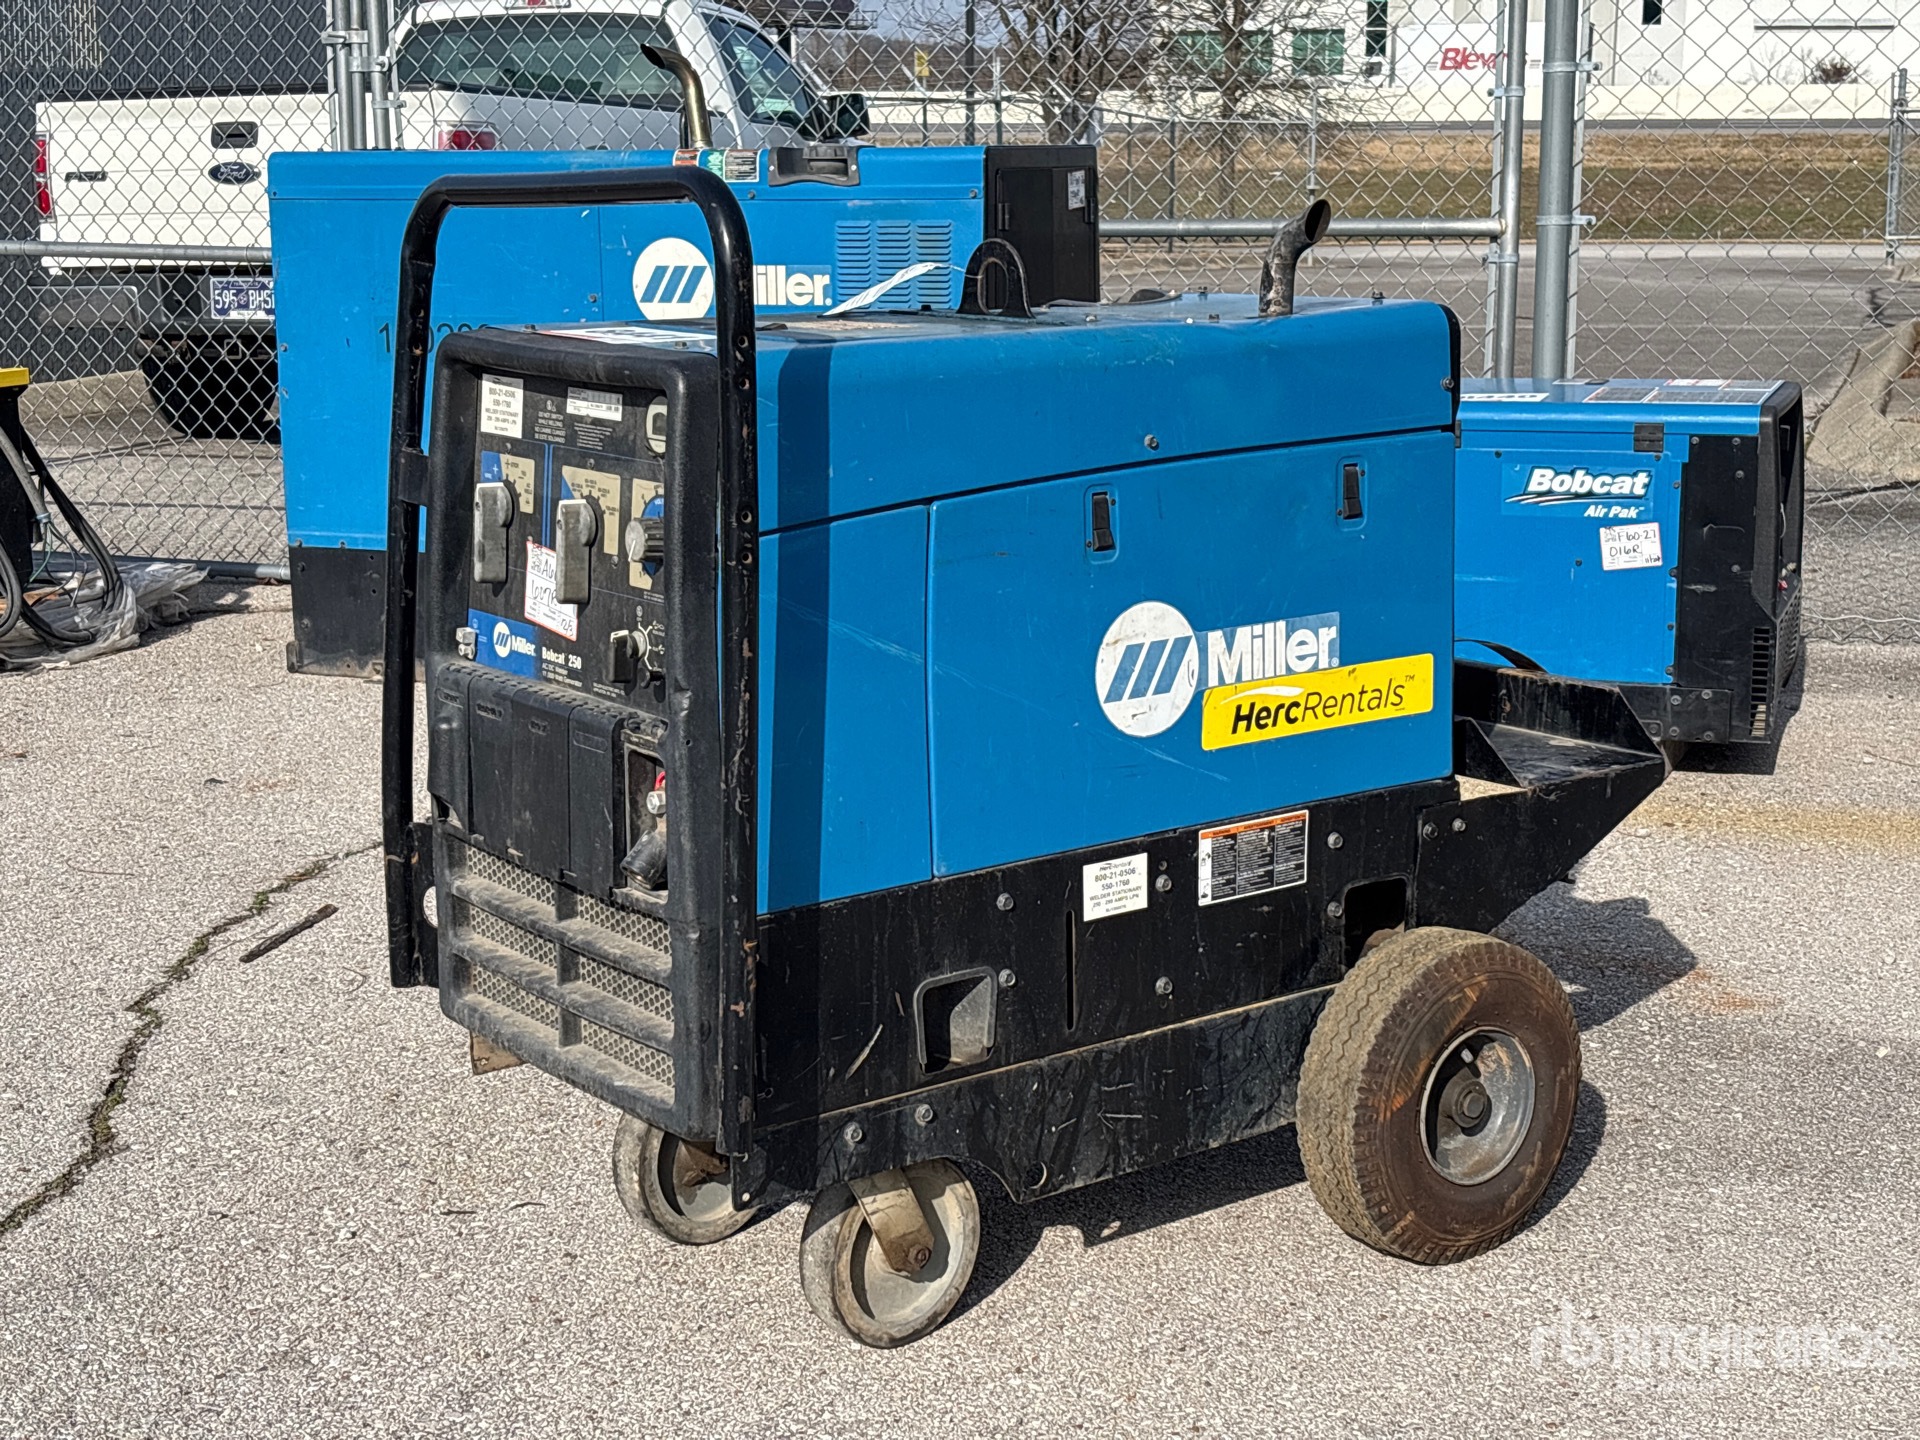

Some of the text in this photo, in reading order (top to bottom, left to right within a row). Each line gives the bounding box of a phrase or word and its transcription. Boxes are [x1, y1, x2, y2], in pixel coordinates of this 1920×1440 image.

[753, 265, 830, 306] iller
[214, 289, 275, 309] 595 BHS
[1527, 467, 1650, 496] Bobcat
[1584, 505, 1639, 518] Air Pak
[511, 634, 535, 656] Miller
[1207, 620, 1337, 688] Miller
[541, 646, 582, 670] Bobcat 250
[1094, 867, 1136, 882] 800-21-0506
[1101, 878, 1130, 891] 550-1760
[1089, 885, 1142, 901] WELDER STATIONARY
